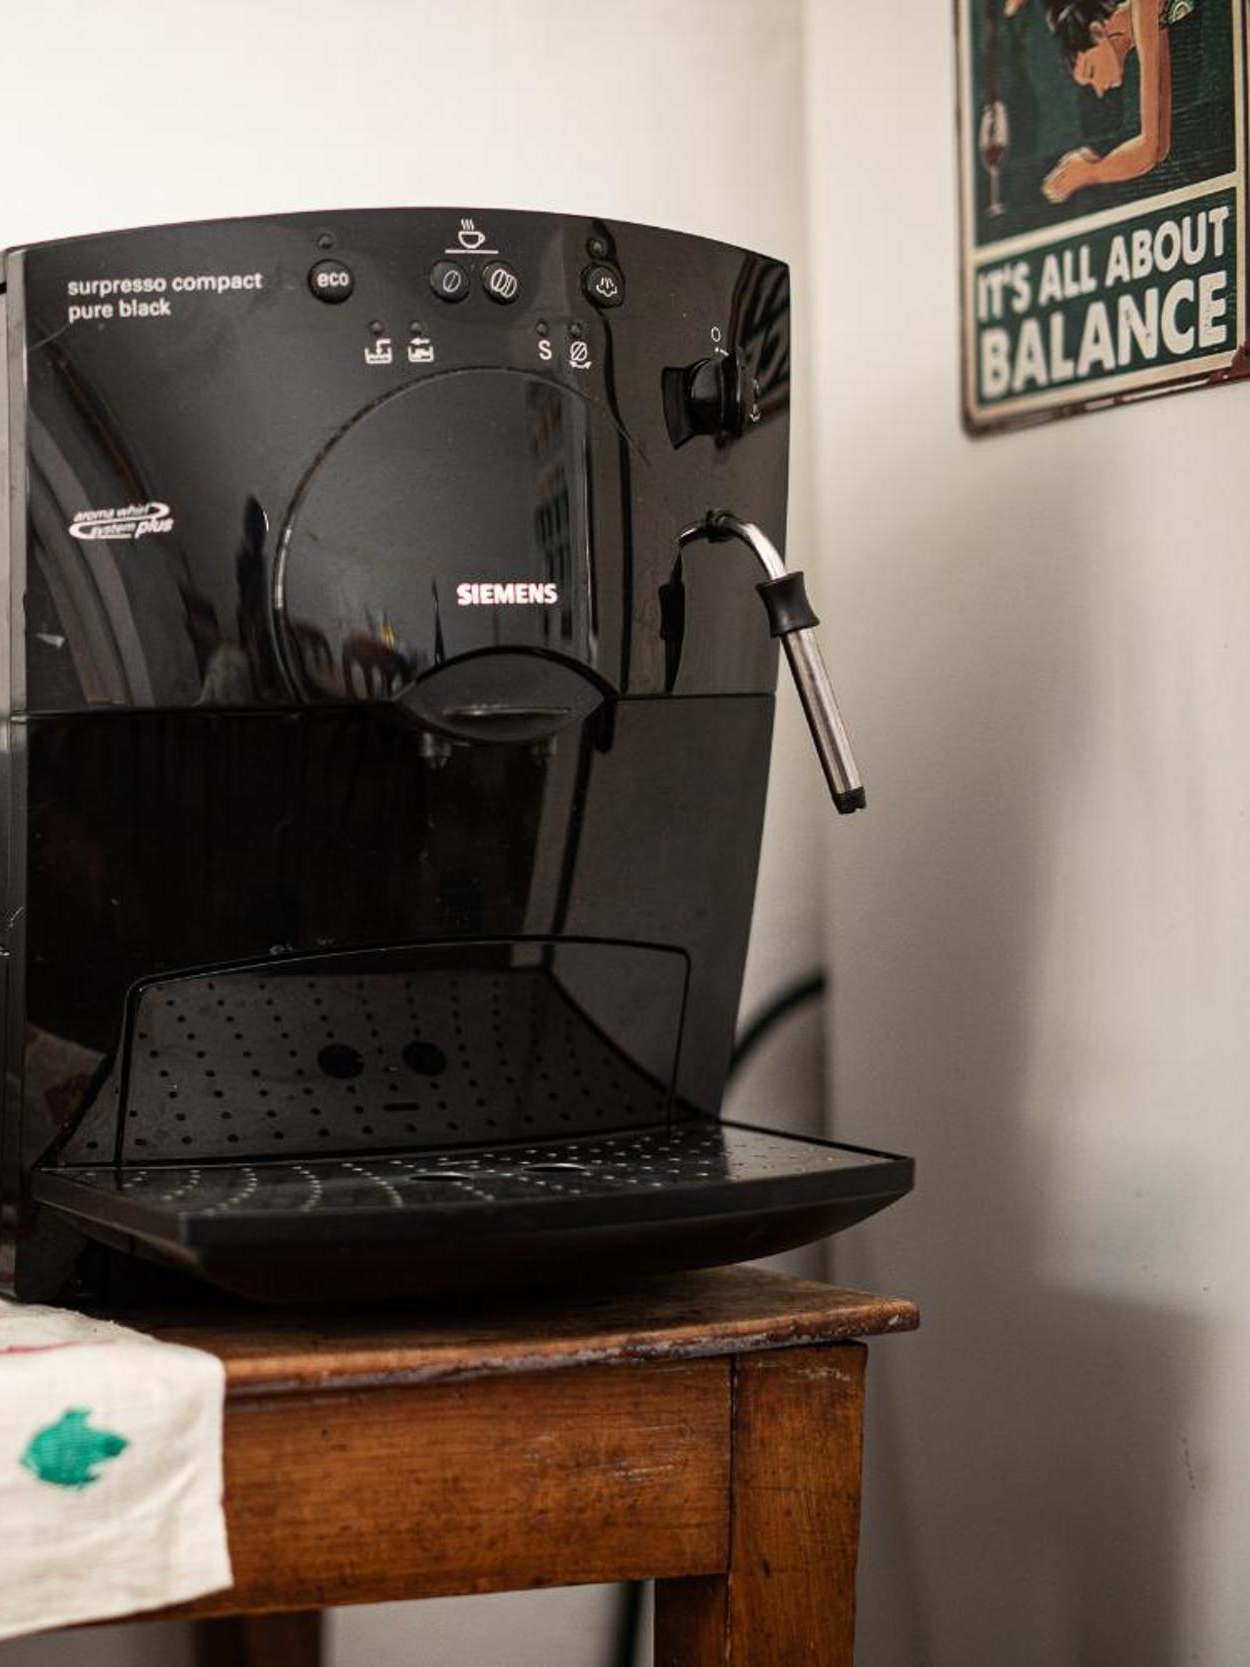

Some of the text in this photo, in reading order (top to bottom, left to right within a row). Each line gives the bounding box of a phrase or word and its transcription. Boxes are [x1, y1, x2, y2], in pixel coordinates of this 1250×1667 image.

[977, 206, 1230, 323] IT'S ALL ABOUT
[67, 272, 263, 298] surpresso compact
[316, 271, 350, 288] eco
[68, 298, 171, 325] pure black
[980, 269, 1228, 399] BALANCE
[538, 340, 552, 361] S
[134, 518, 174, 539] plus
[456, 582, 558, 605] SIEMENS
